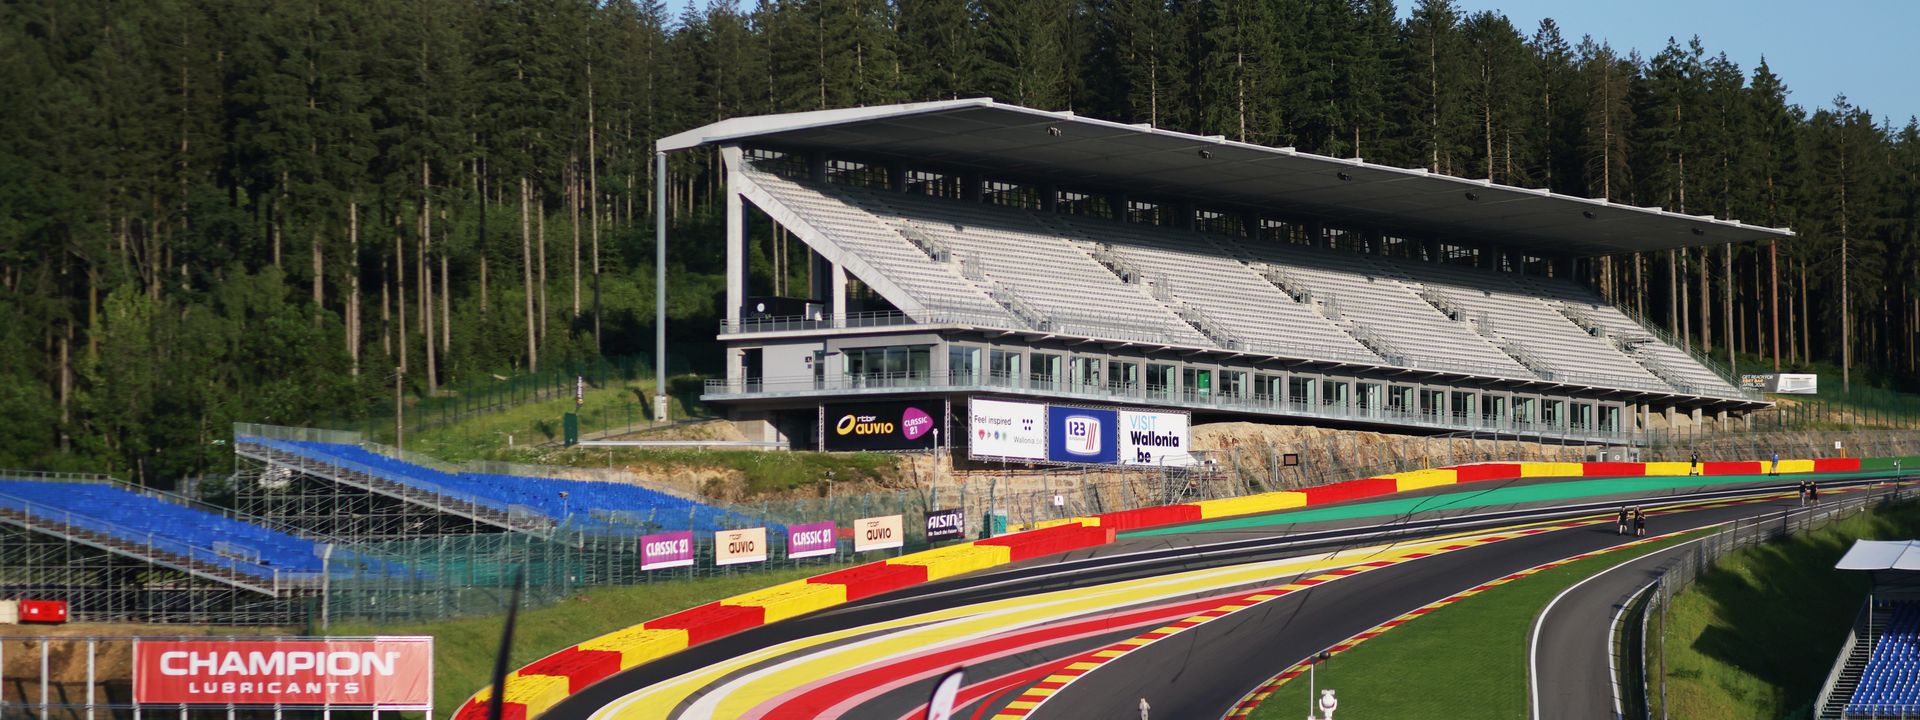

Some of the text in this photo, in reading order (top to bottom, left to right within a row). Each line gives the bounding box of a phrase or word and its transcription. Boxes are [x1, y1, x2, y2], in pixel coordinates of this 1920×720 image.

[904, 417, 928, 427] CLASSIC
[974, 415, 1012, 426] Feel inspired
[1130, 415, 1157, 430] VISIT
[855, 422, 893, 434] auvio
[909, 426, 918, 435] 21
[1069, 421, 1086, 436] 123
[1130, 430, 1179, 447] Wallonia
[928, 514, 957, 529] AISIN
[793, 529, 831, 546] CLASSIC 21
[866, 527, 892, 540] auvio
[646, 539, 689, 557] CLASSIC 21
[729, 541, 754, 554] auvio
[160, 651, 396, 676] CHAMPION
[189, 682, 361, 695] LUBRICANTS
